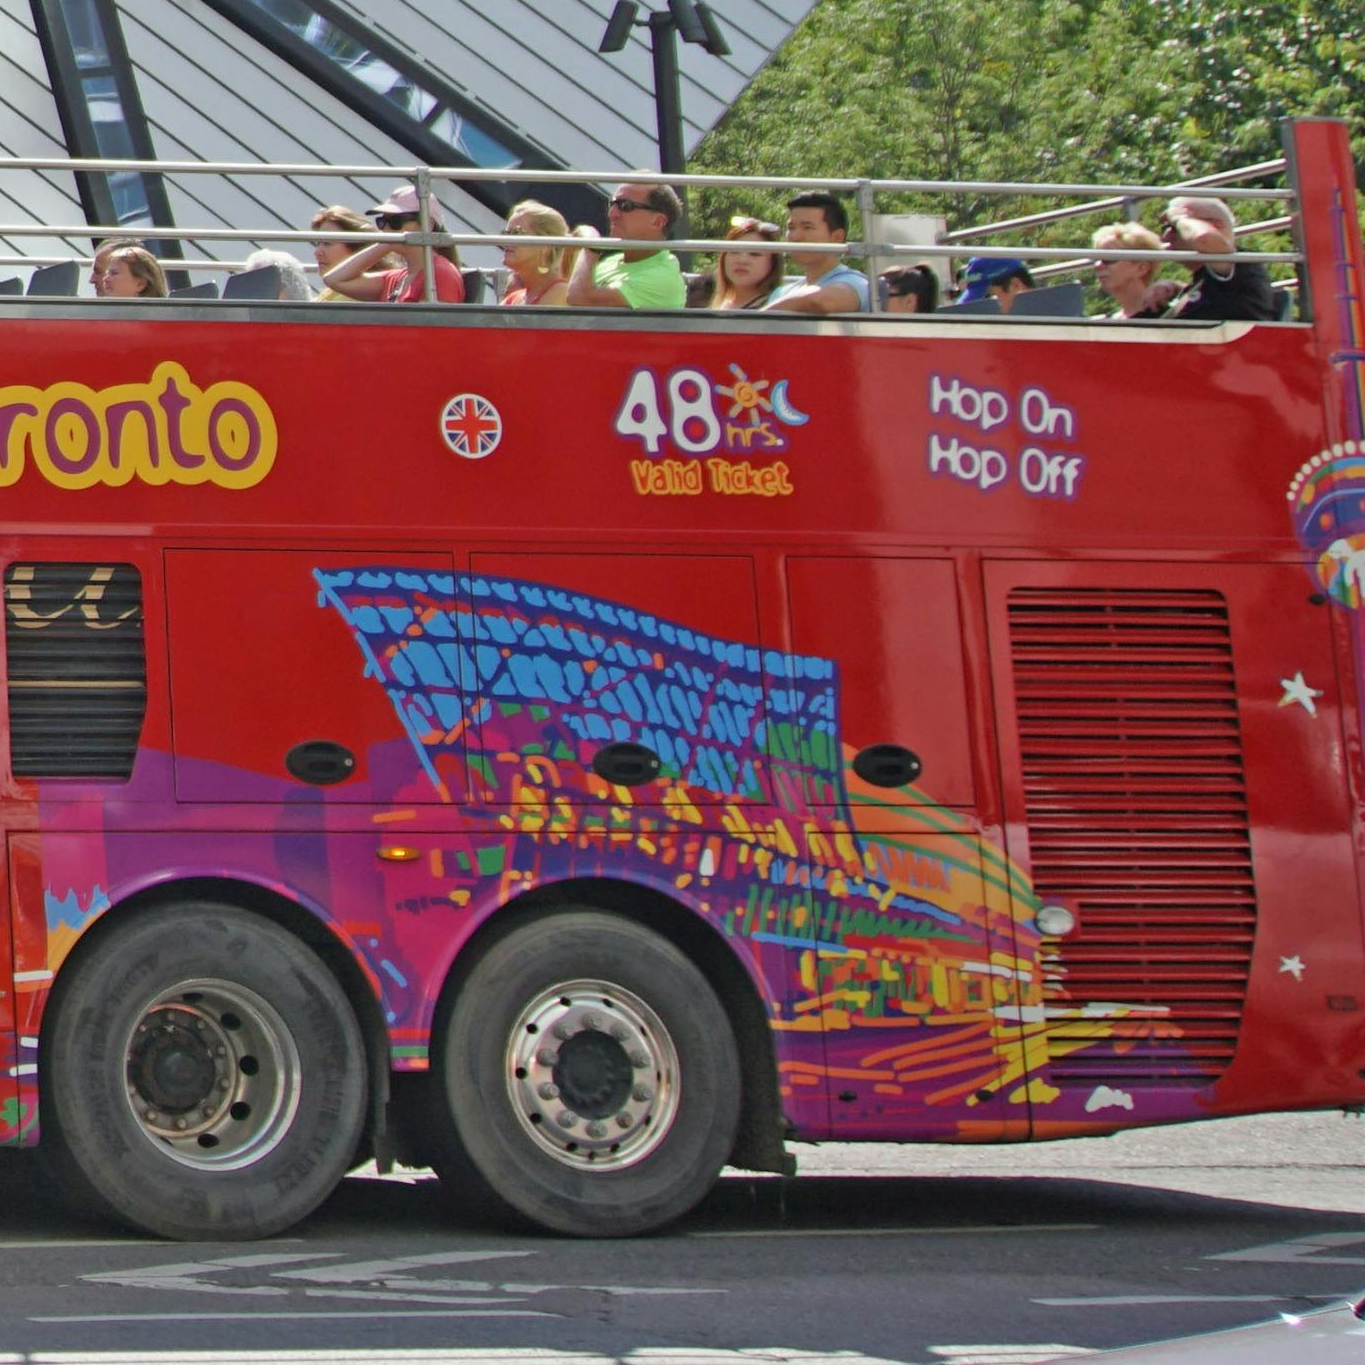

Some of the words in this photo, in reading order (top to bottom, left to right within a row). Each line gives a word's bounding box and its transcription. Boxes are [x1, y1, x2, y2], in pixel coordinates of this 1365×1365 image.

[617, 370, 720, 452] 48
[932, 376, 1008, 429] Hop
[1021, 389, 1072, 436] On
[631, 458, 702, 495] Valid
[707, 457, 794, 496] Ticket
[930, 435, 1007, 489] Hop
[1020, 448, 1082, 495] Off
